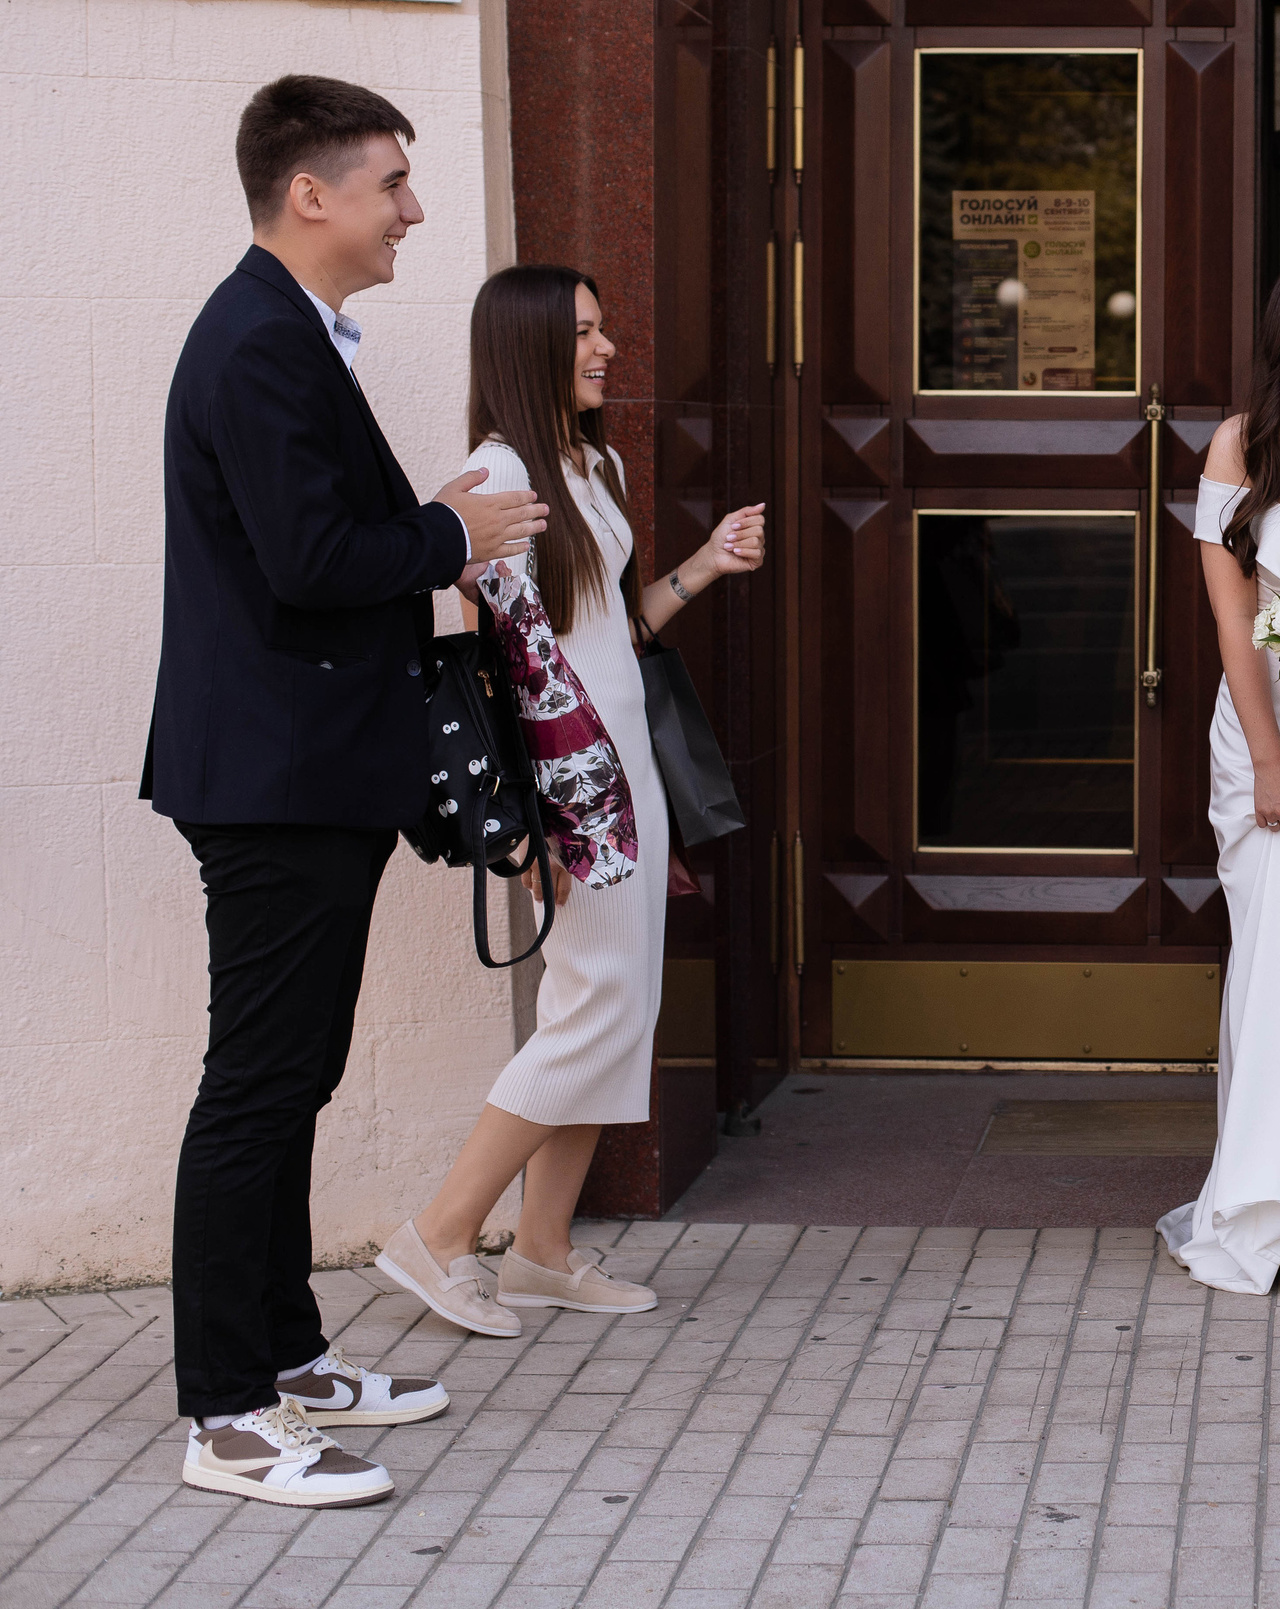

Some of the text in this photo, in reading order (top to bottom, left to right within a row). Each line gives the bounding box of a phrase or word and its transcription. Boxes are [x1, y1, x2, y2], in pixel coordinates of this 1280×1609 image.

[960, 196, 1038, 211] ГОЛОСУЙ
[1054, 198, 1090, 207] 8-9-10
[960, 211, 1025, 225] ОНЛАЙН
